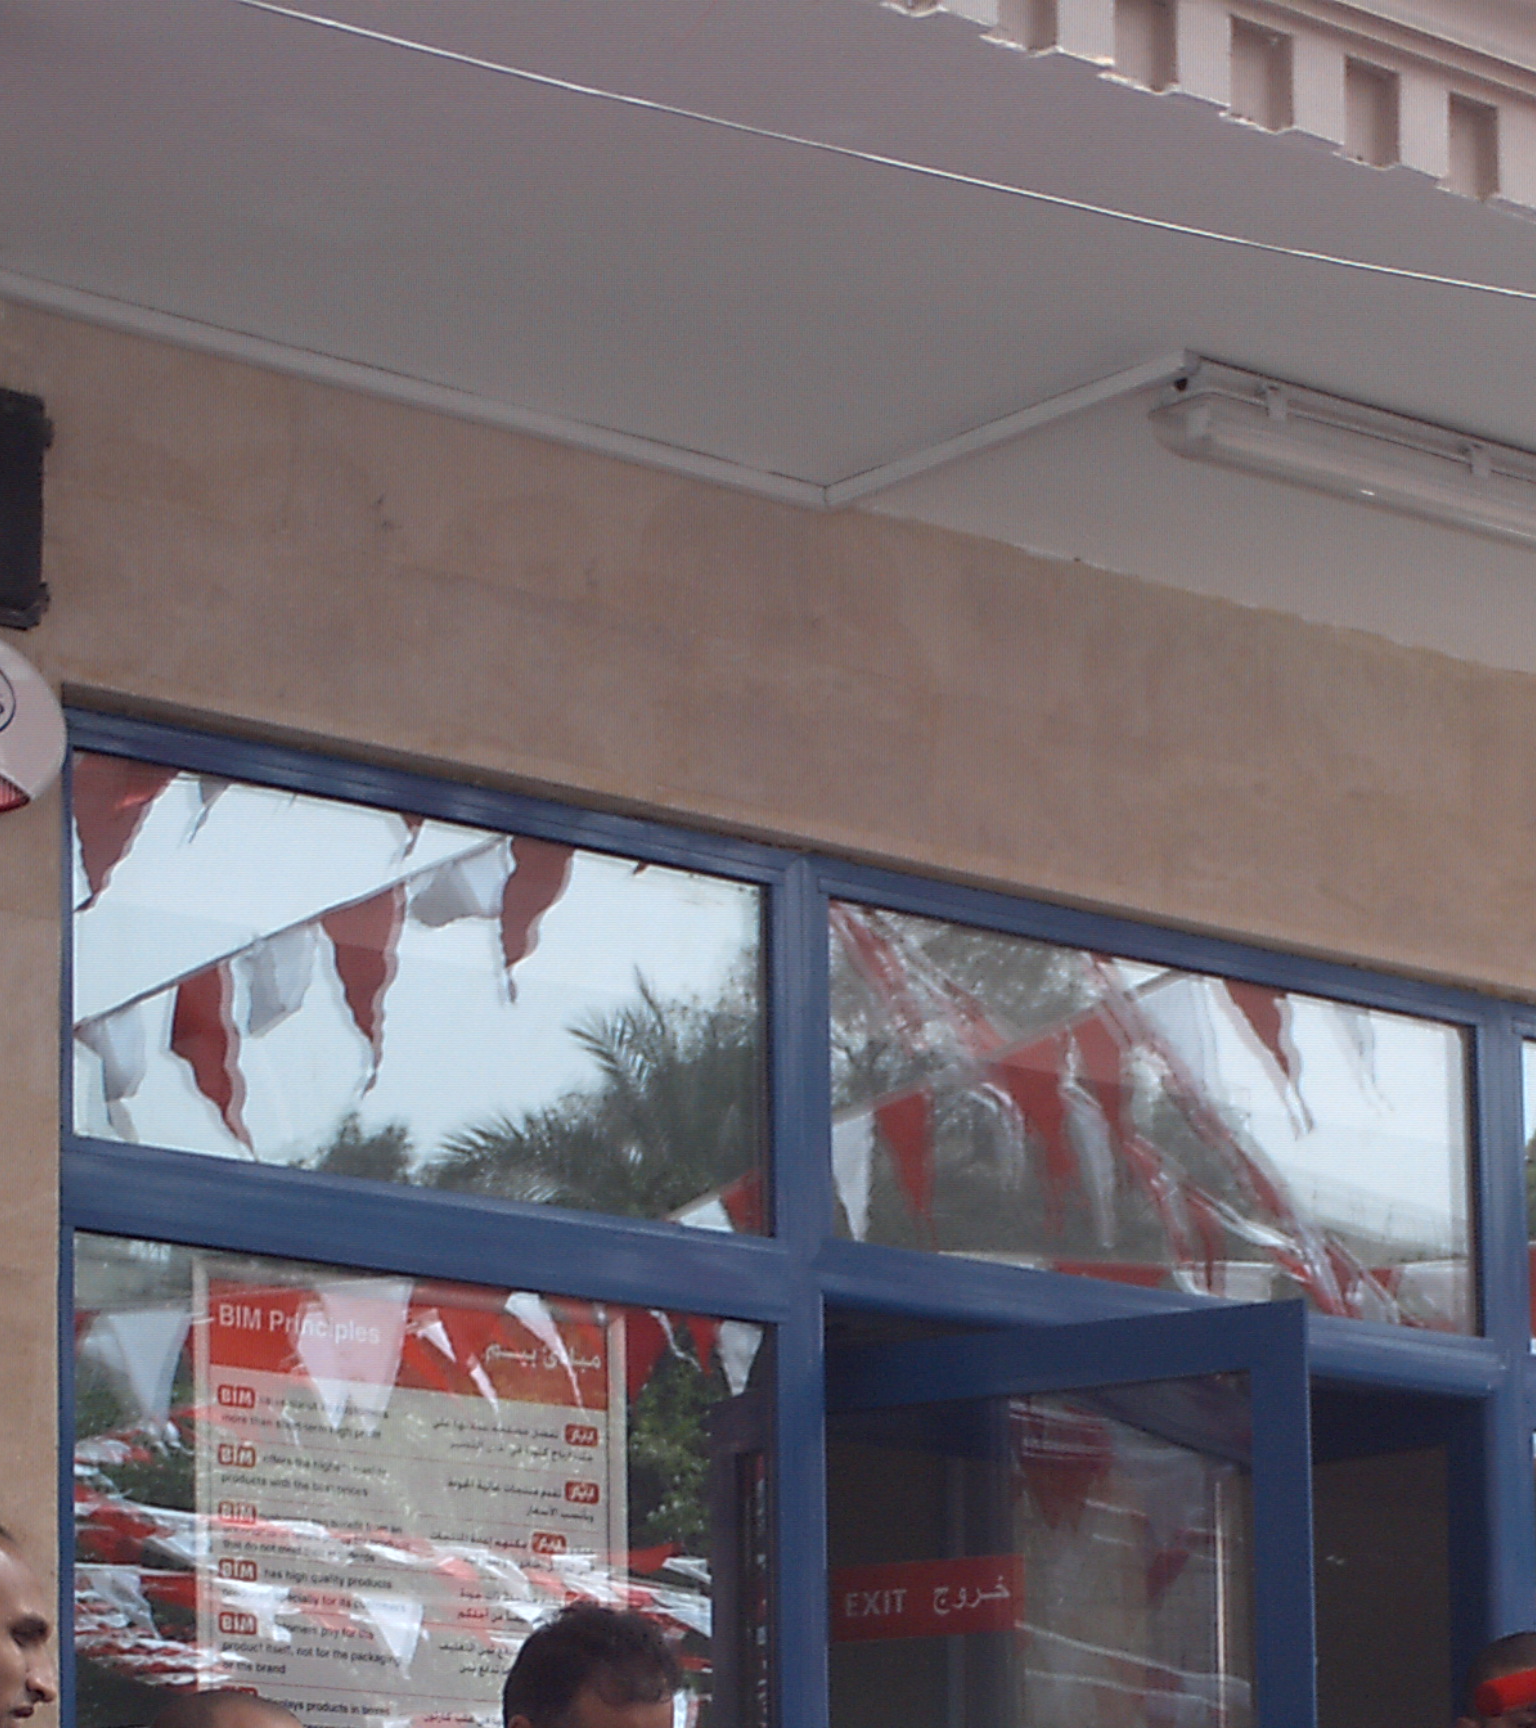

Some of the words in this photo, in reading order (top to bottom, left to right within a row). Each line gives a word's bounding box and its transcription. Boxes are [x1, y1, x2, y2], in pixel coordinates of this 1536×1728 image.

[219, 1305, 261, 1329] BIM
[269, 1310, 381, 1345] Principles
[219, 1386, 255, 1408] BIM
[219, 1445, 256, 1467] BIM
[219, 1559, 256, 1581] BIM
[264, 1568, 282, 1578] has
[285, 1570, 308, 1583] high
[311, 1572, 345, 1587] quality
[347, 1575, 392, 1589] products
[845, 1589, 907, 1617] EXIT
[932, 1575, 1011, 1616] خروج
[219, 1613, 257, 1635] BIM
[221, 1641, 263, 1653] product
[296, 1646, 313, 1656] not
[316, 1647, 330, 1658] for
[332, 1648, 348, 1659] the
[236, 1661, 253, 1672] the
[255, 1662, 287, 1674] brand
[307, 1702, 349, 1716] products
[351, 1704, 360, 1714] in
